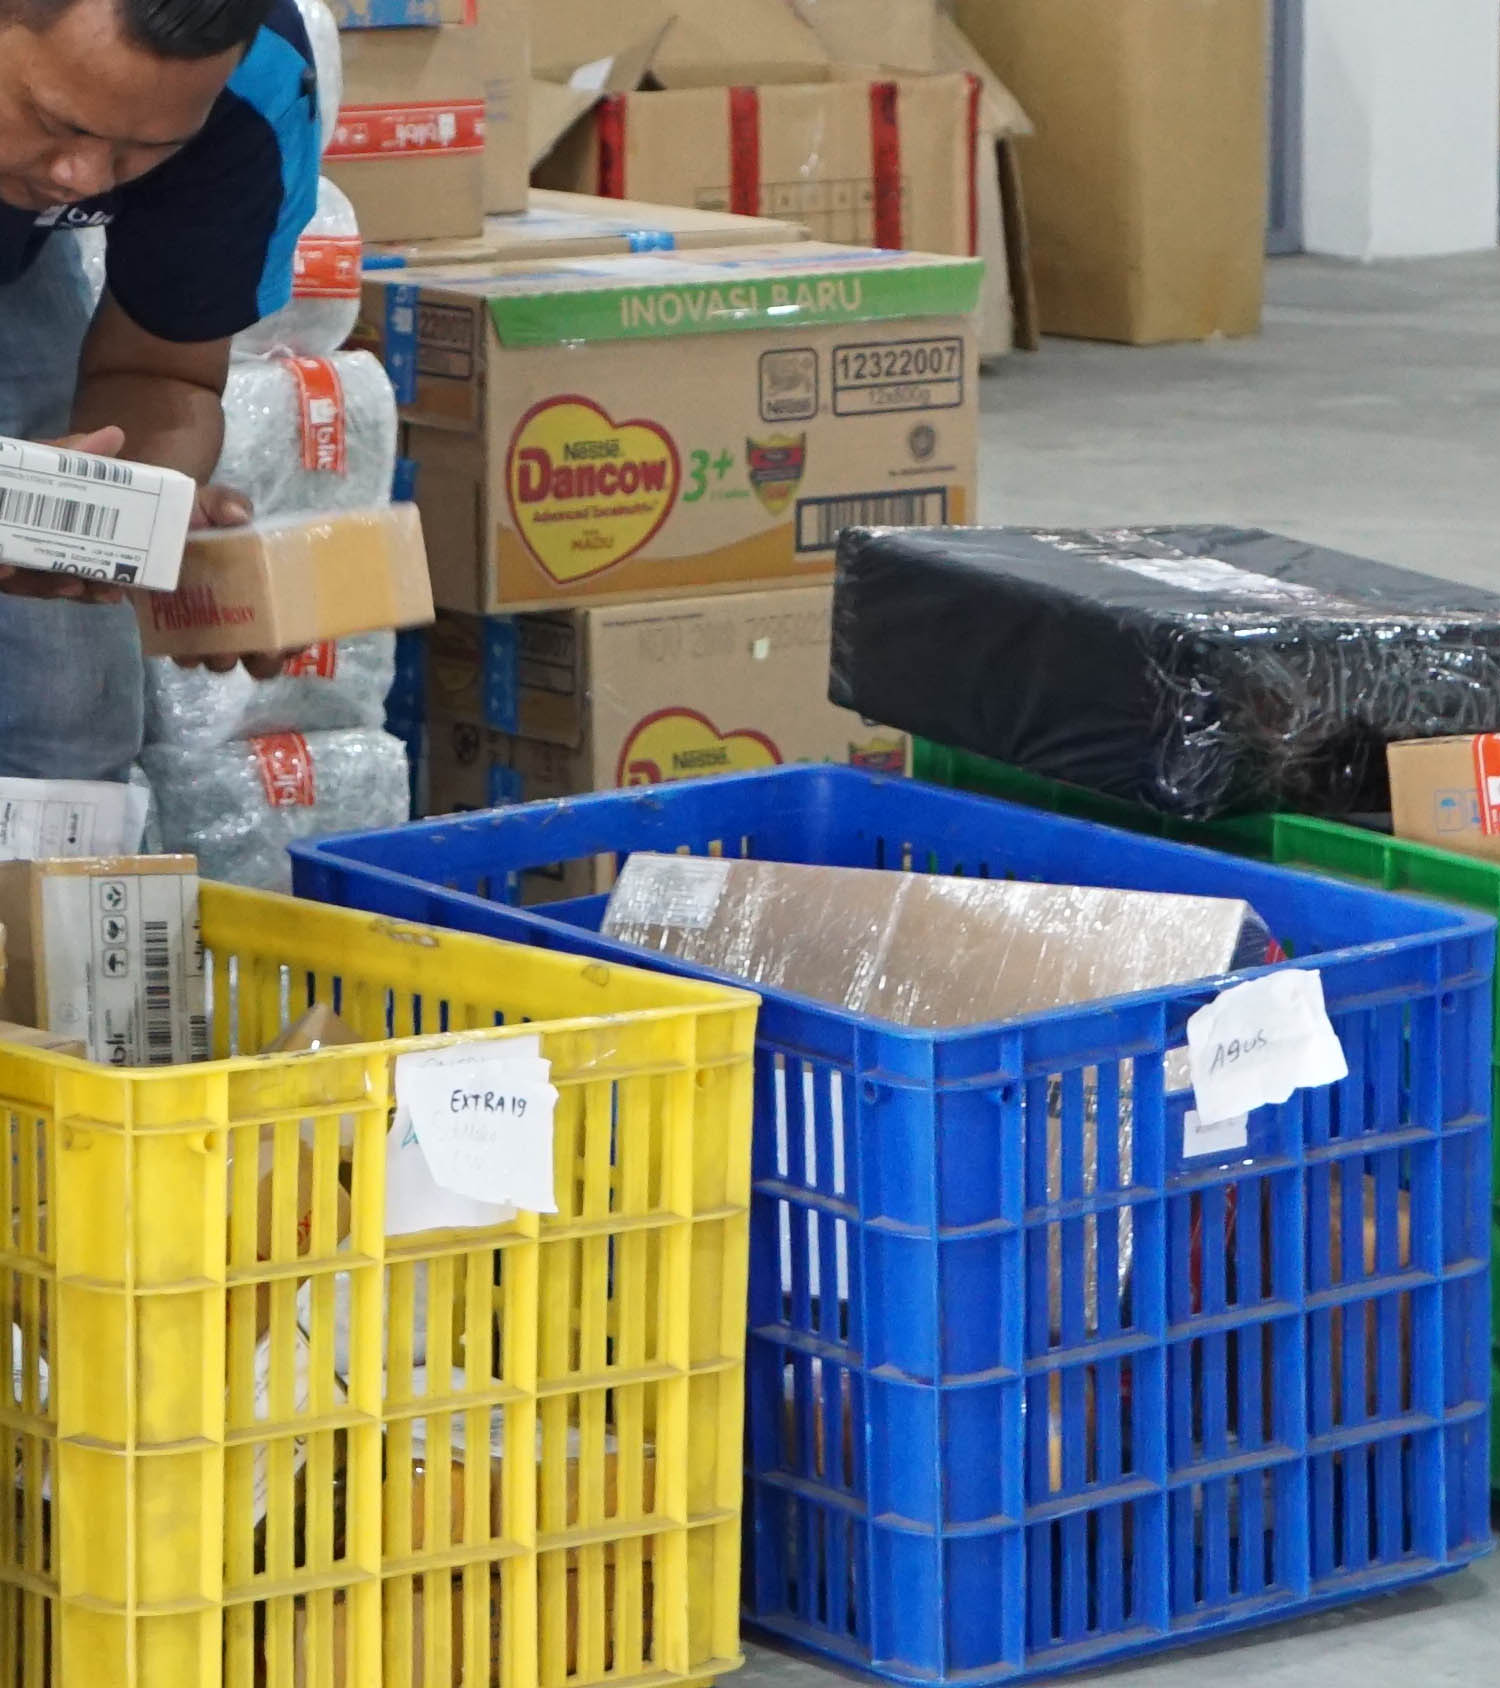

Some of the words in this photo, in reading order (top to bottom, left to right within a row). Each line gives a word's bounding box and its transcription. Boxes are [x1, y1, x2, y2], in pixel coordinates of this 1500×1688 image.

[619, 283, 759, 329] INOVASI
[771, 278, 864, 315] BARU
[840, 346, 958, 380] 12322007
[517, 445, 668, 504] Dancow
[682, 446, 735, 502] 3+
[450, 1088, 506, 1114] EXTRA
[510, 1096, 528, 1118] 19
